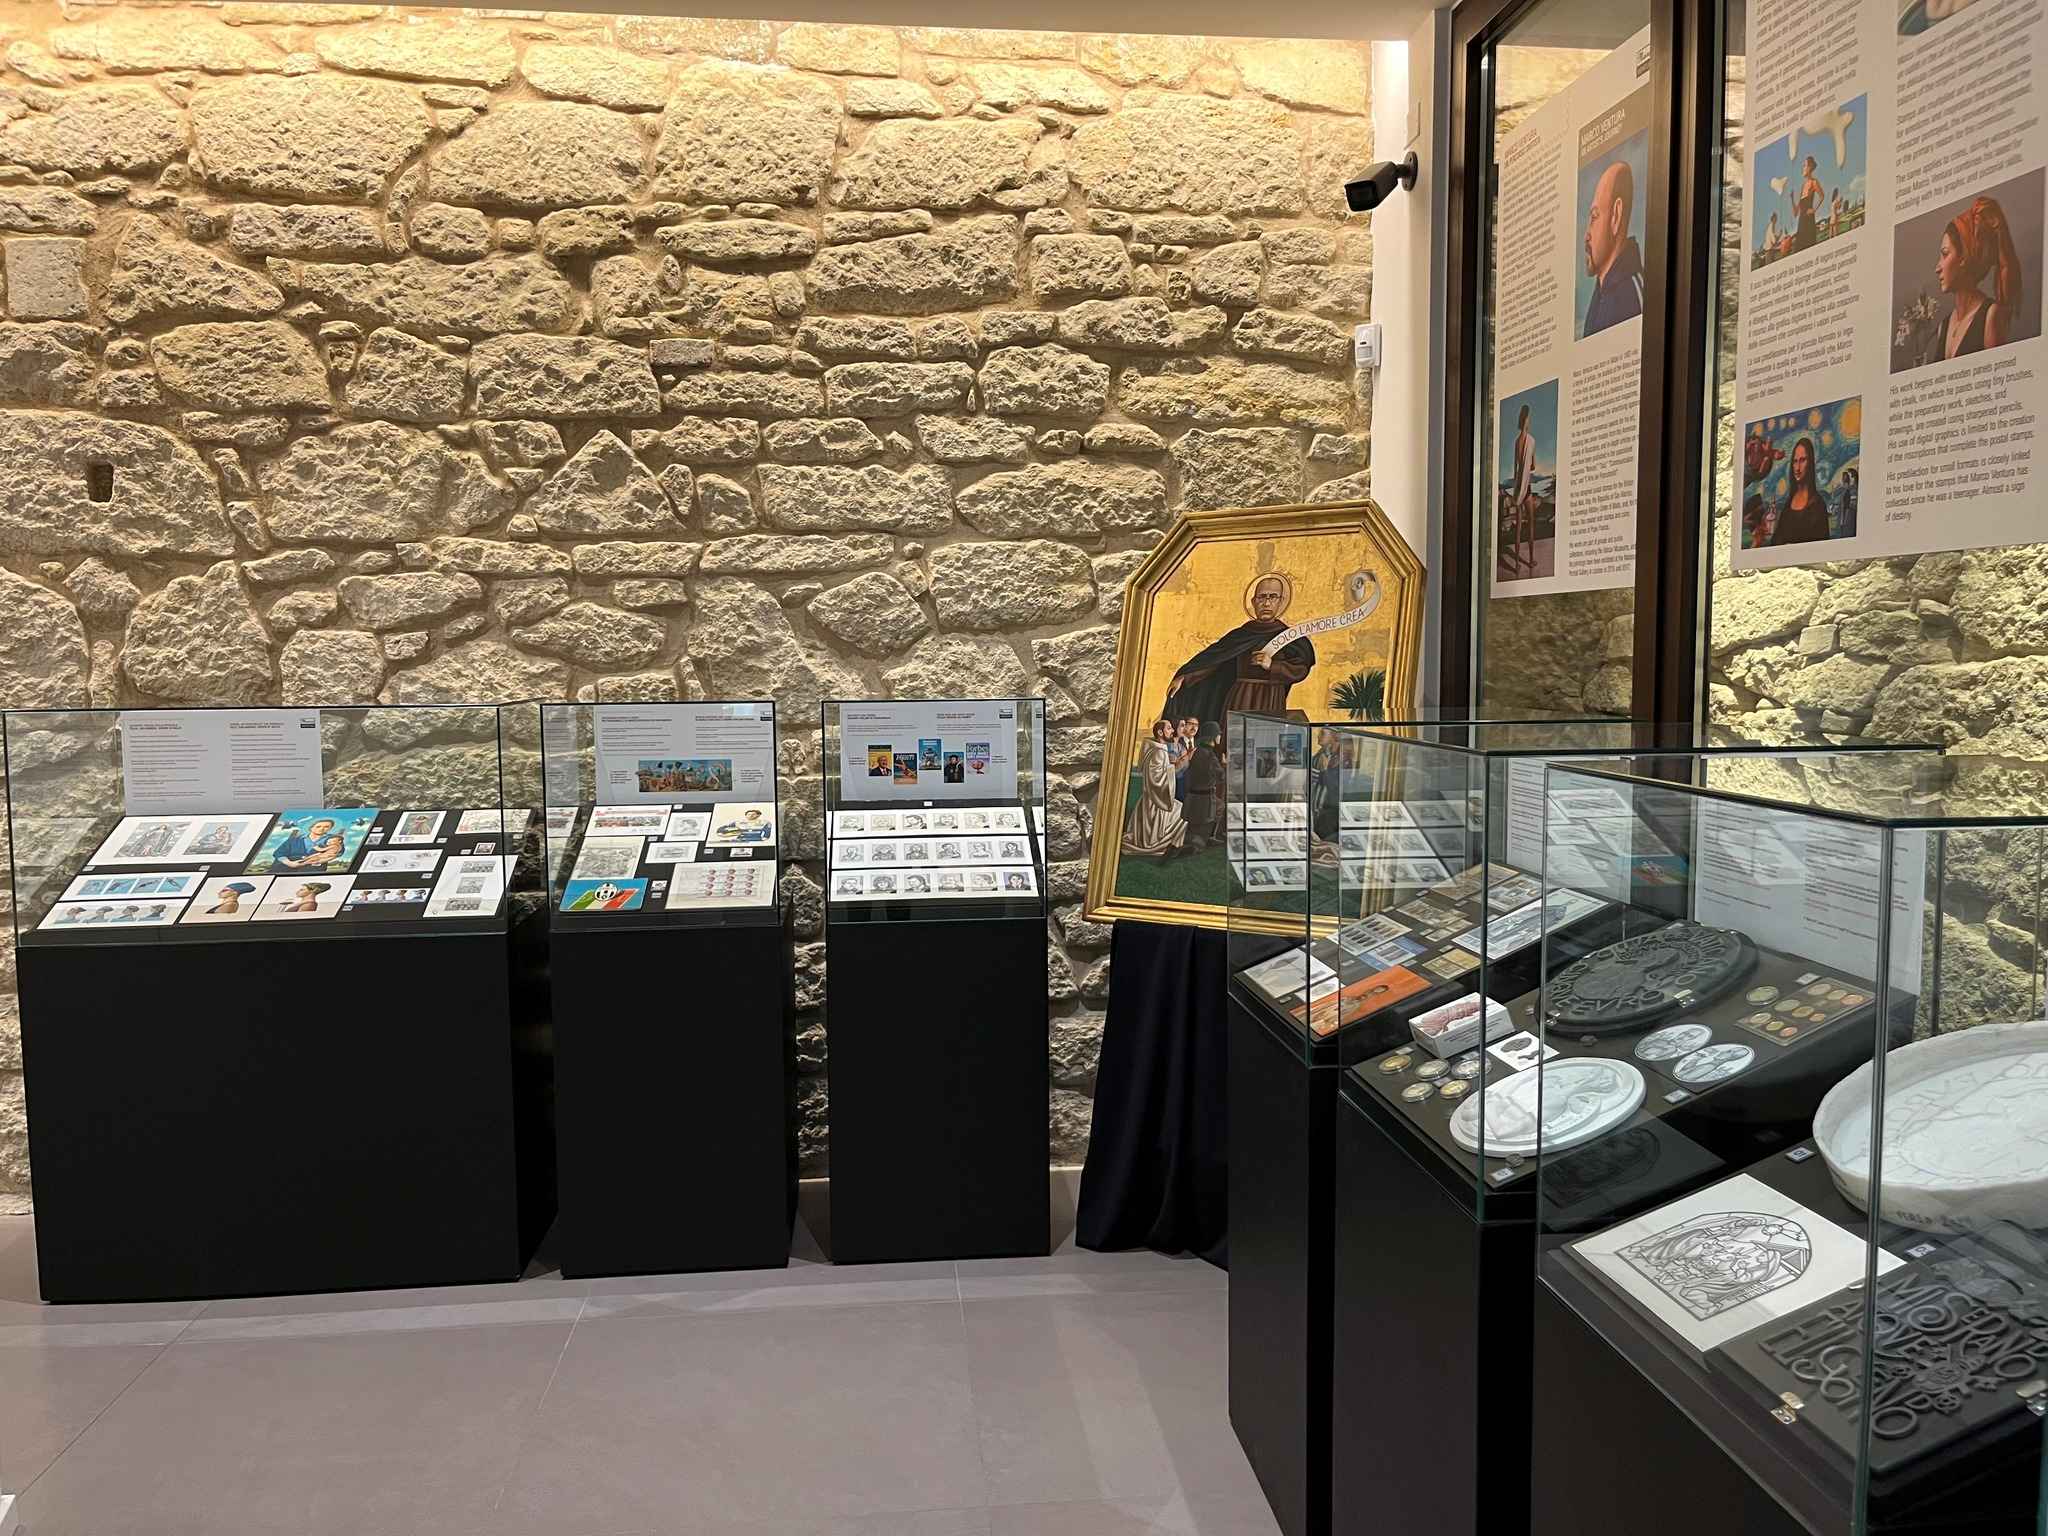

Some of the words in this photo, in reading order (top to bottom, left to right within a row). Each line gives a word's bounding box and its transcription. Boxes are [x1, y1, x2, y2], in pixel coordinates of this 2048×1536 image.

[1271, 628, 1298, 650] SOLO
[1299, 617, 1338, 636] L'AMORE
[1339, 607, 1365, 626] CREA
[966, 744, 990, 754] Forbes
